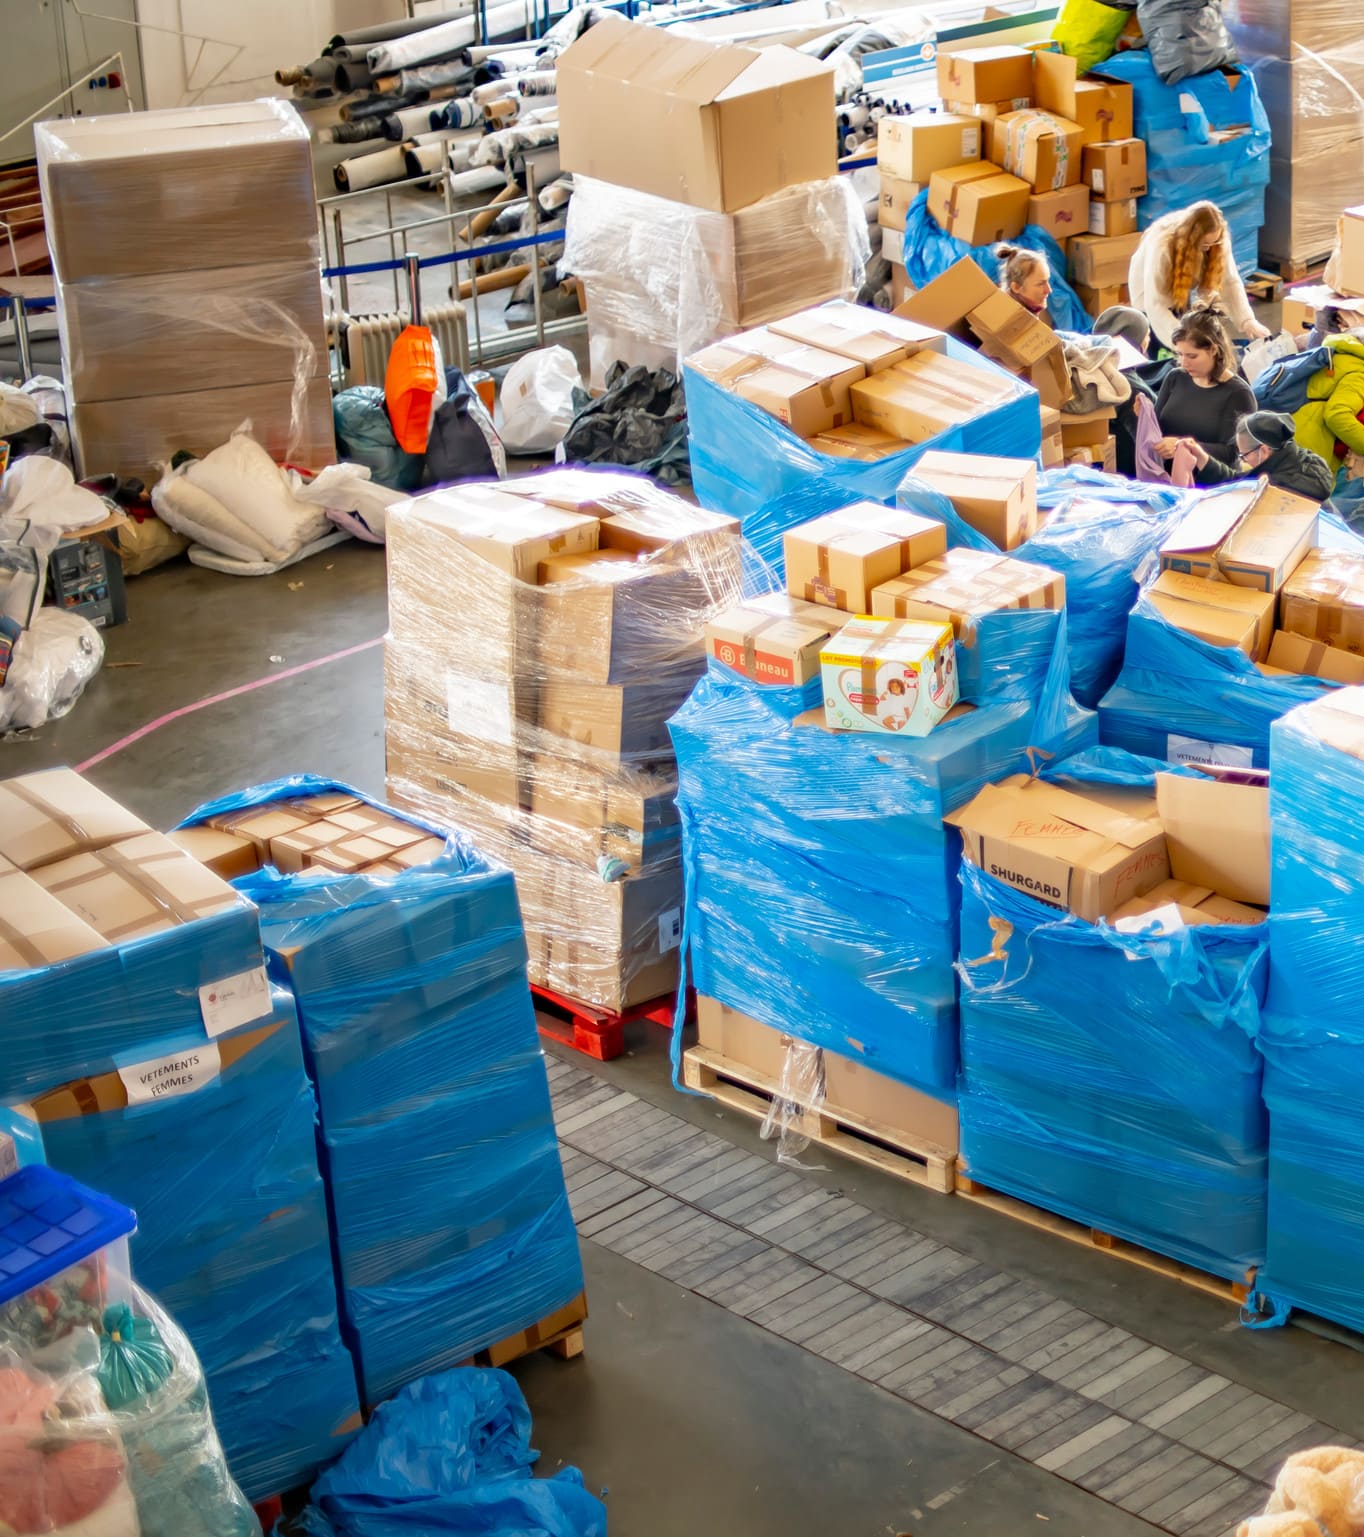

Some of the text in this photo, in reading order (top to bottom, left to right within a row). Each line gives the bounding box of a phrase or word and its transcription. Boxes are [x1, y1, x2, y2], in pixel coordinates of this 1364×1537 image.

[739, 653, 789, 678] Bneau
[990, 863, 1061, 899] SHURGARD
[139, 1055, 200, 1085] VETEMENTS
[151, 1074, 194, 1097] FEMMES
